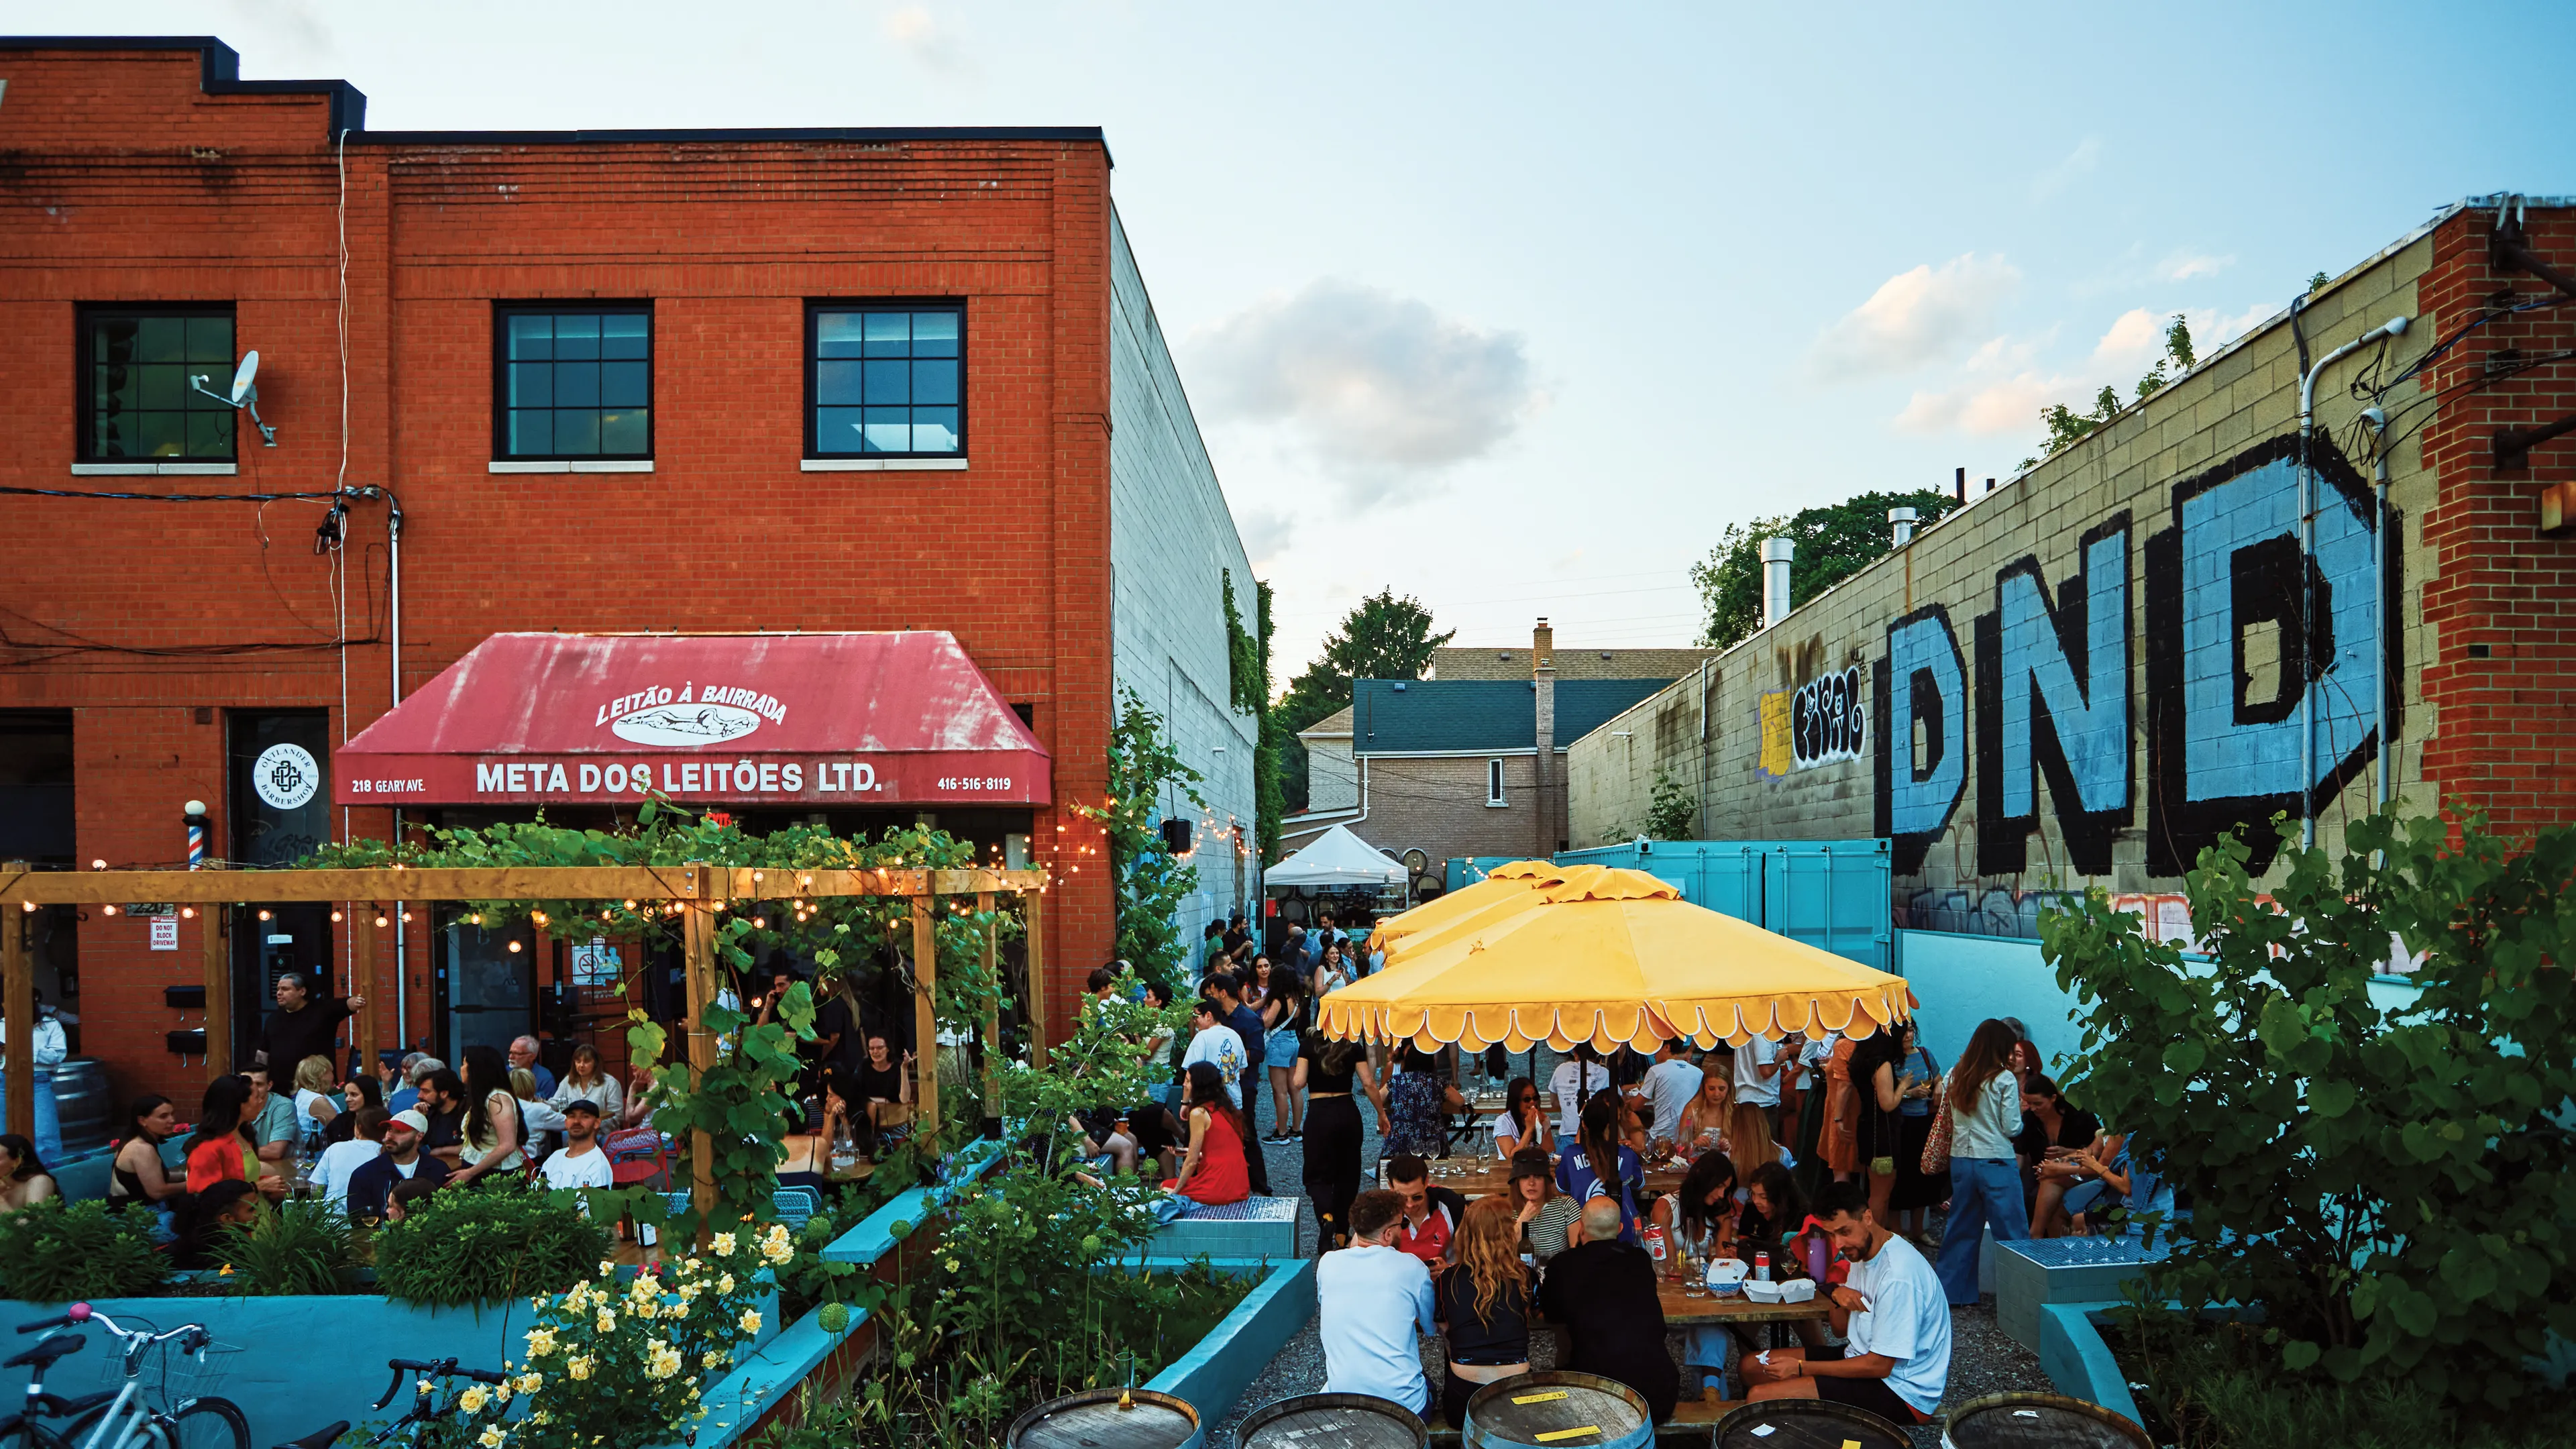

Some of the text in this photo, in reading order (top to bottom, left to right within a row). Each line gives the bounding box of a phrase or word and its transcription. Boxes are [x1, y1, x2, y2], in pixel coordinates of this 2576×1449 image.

[596, 681, 787, 727] LEITÃO À BAIRRADA
[262, 749, 311, 768] OUTLANDER
[352, 779, 426, 792] 218 GEARY AVE.
[477, 759, 882, 793] META DOS LEITÕES LTD.
[937, 777, 1011, 790] 416-516-8119
[262, 784, 313, 805] BARBERSHOP
